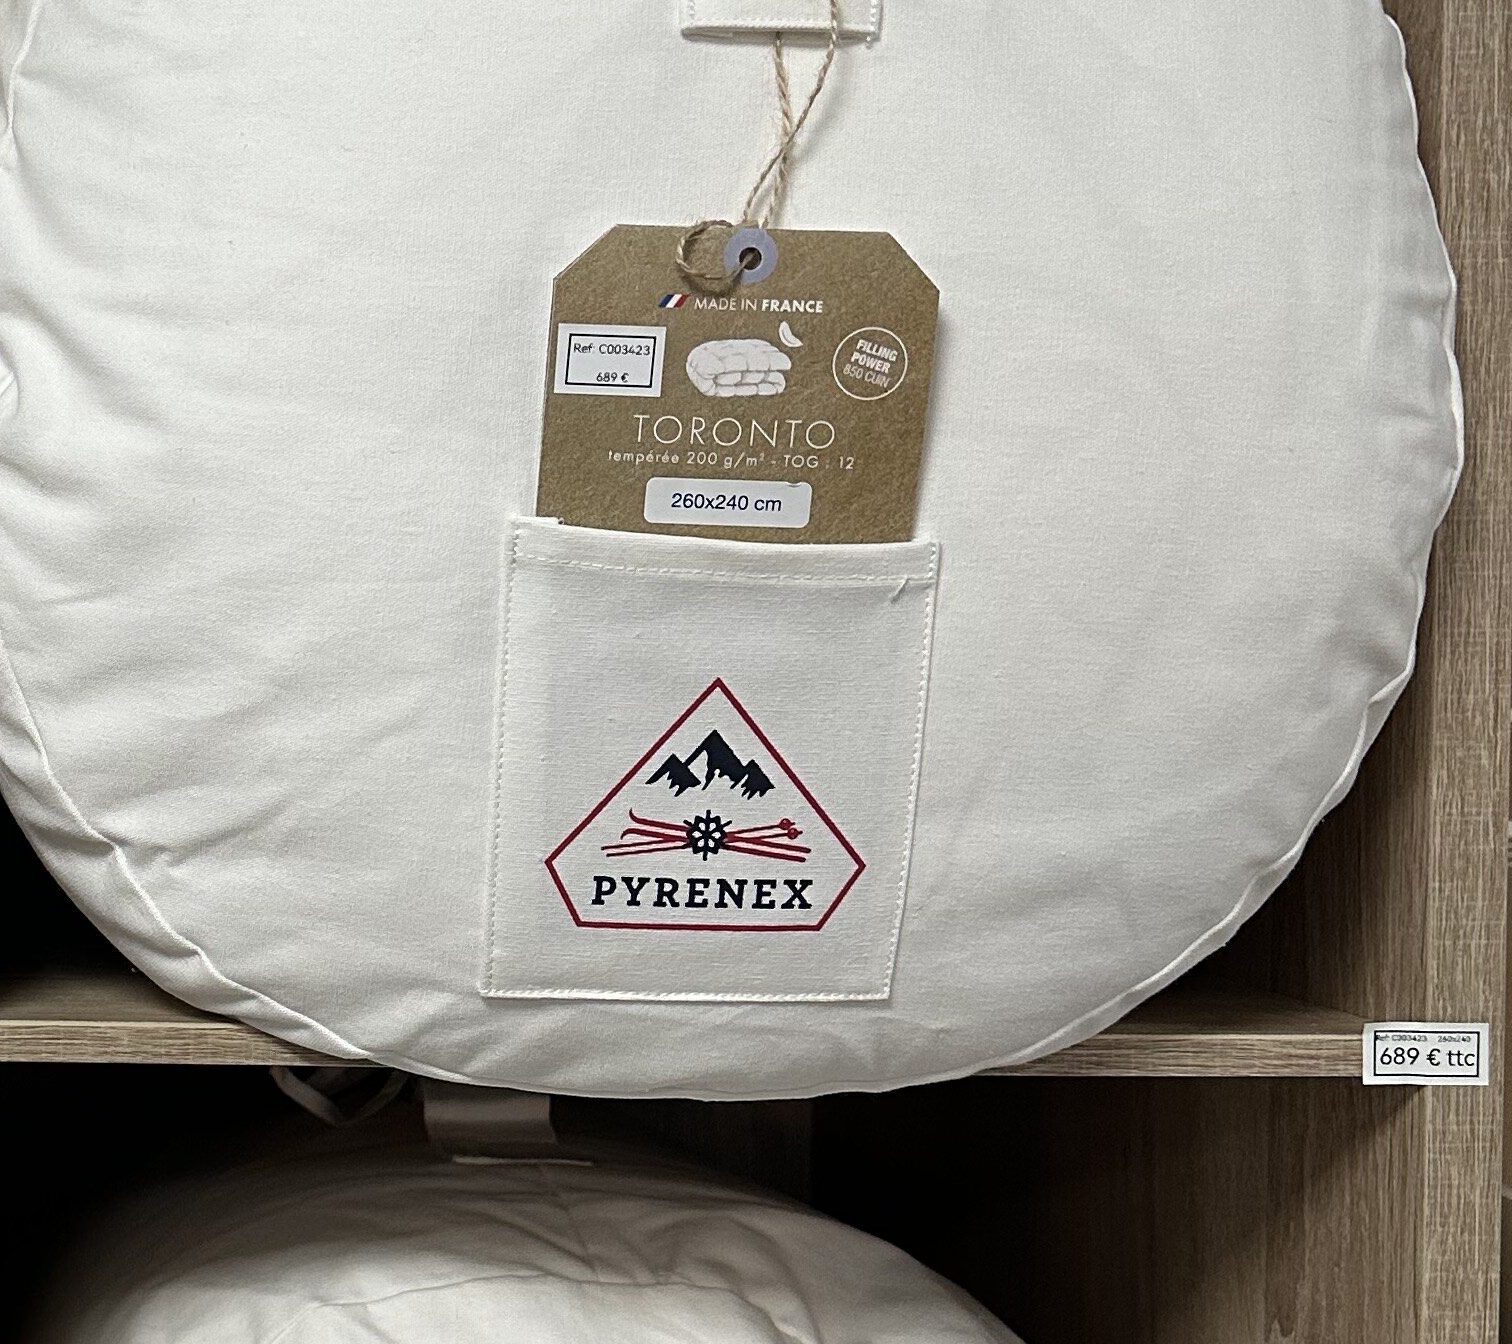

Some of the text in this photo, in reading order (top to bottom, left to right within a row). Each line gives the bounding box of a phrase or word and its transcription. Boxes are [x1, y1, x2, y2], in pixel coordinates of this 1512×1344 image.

[694, 298, 824, 314] MADE IN FRANCE
[599, 344, 650, 355] C003423
[856, 339, 898, 362] FILLING
[851, 351, 891, 374] POWER
[596, 372, 629, 383] 689 €
[843, 363, 891, 388] 850 CUIN
[633, 414, 835, 449] TORONTO
[608, 450, 679, 466] tempérée
[687, 452, 718, 465] 200
[783, 454, 819, 469] TOG
[839, 456, 855, 469] 12
[671, 493, 782, 511] 260x240 cm
[591, 875, 813, 909] PYRENEX
[1380, 1047, 1476, 1067] 689 € ttc
